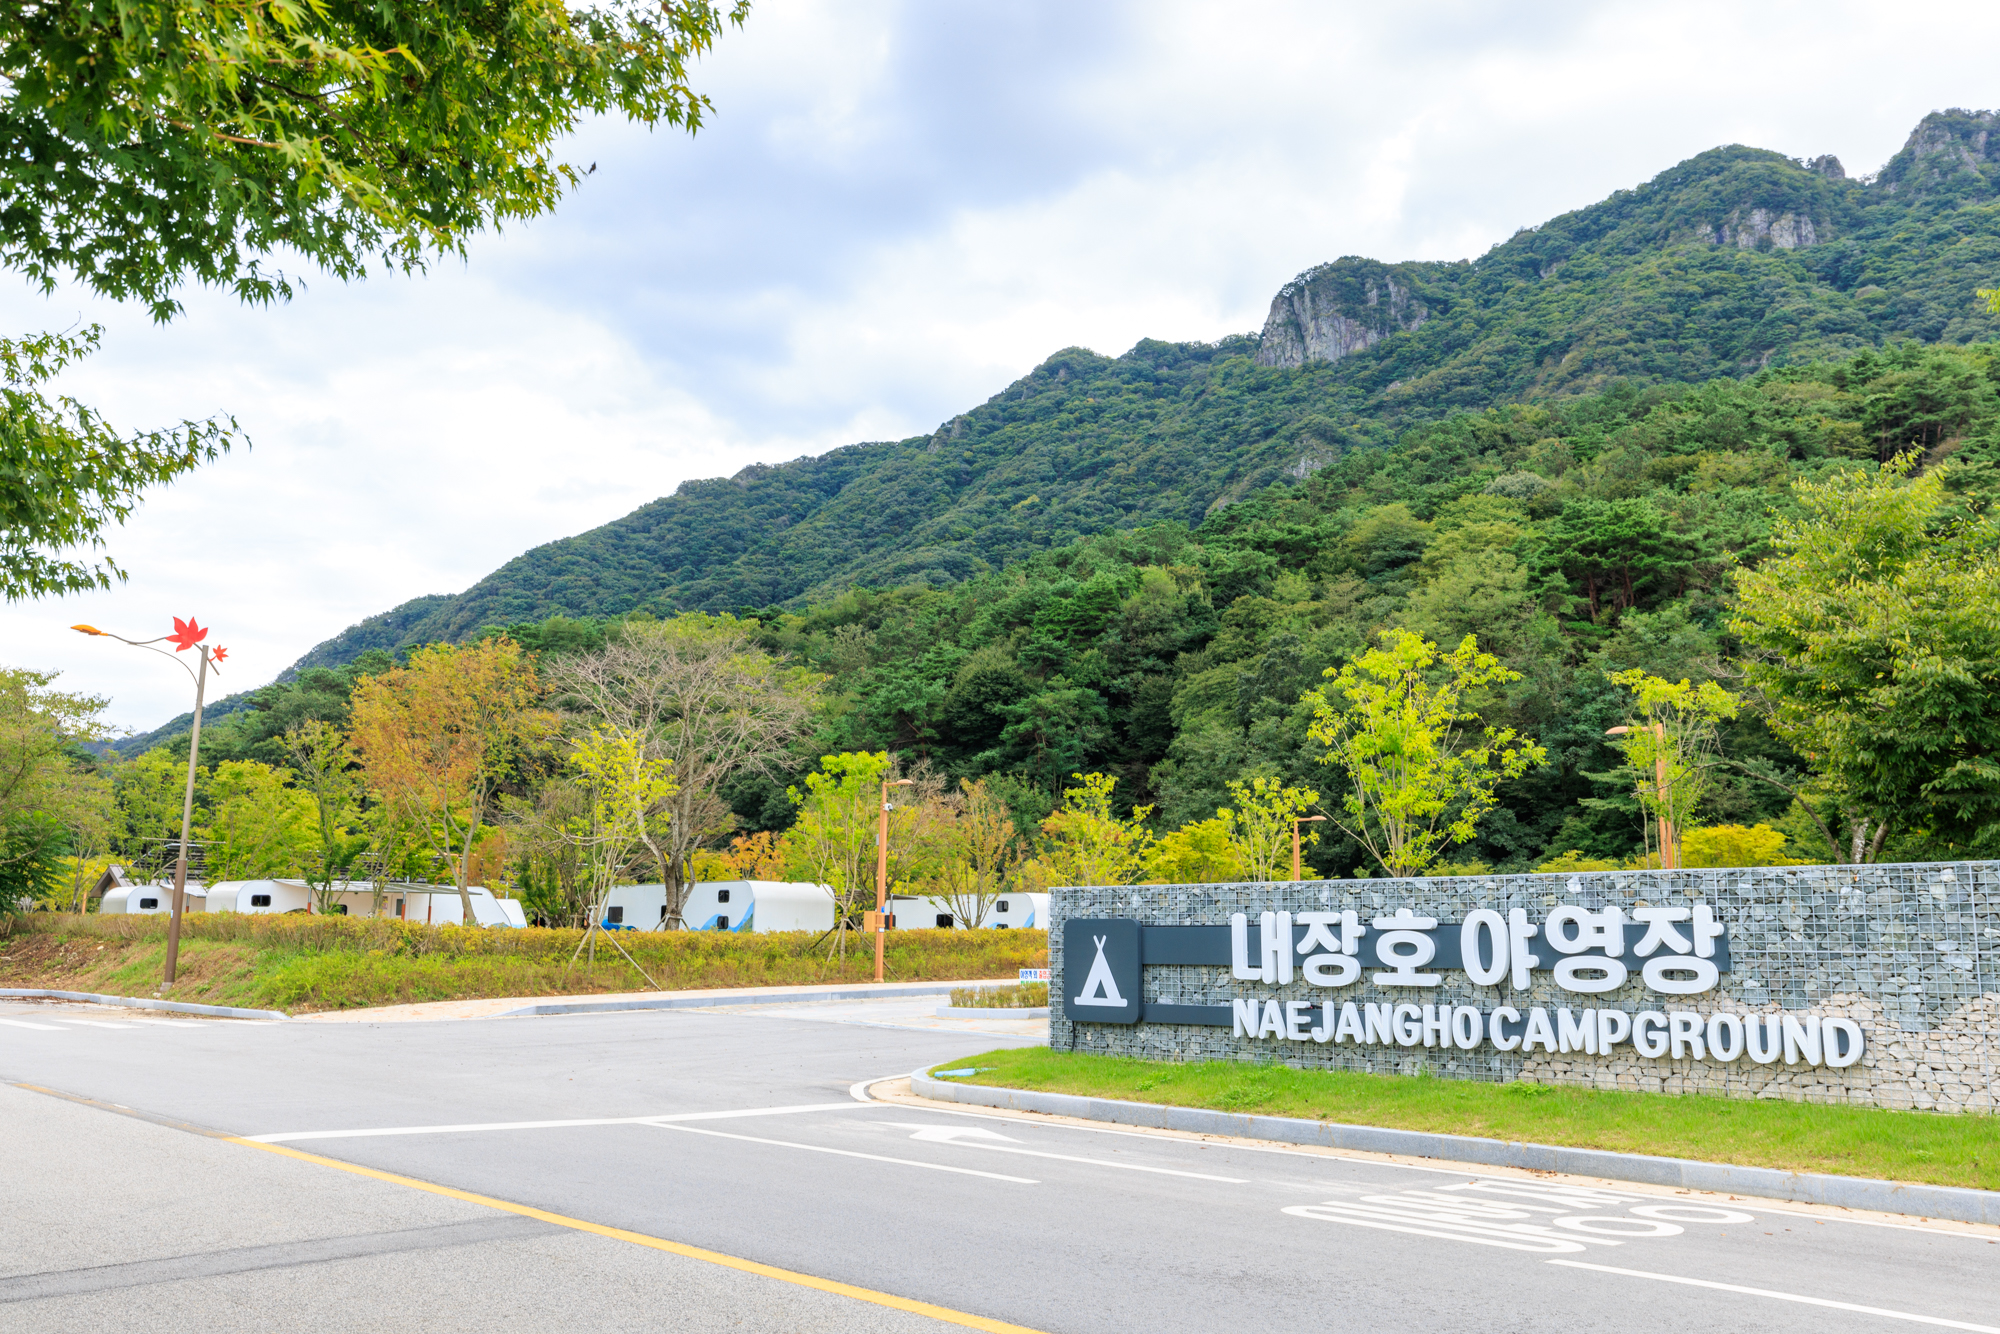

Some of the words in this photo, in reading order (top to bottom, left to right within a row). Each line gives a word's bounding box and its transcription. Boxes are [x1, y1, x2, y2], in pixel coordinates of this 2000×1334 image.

[1231, 907, 1442, 987] 내장호
[1460, 904, 1725, 994] 야영장
[1232, 998, 1483, 1050] NAEJANGHO
[1489, 1005, 1864, 1068] CAMPGROUND
